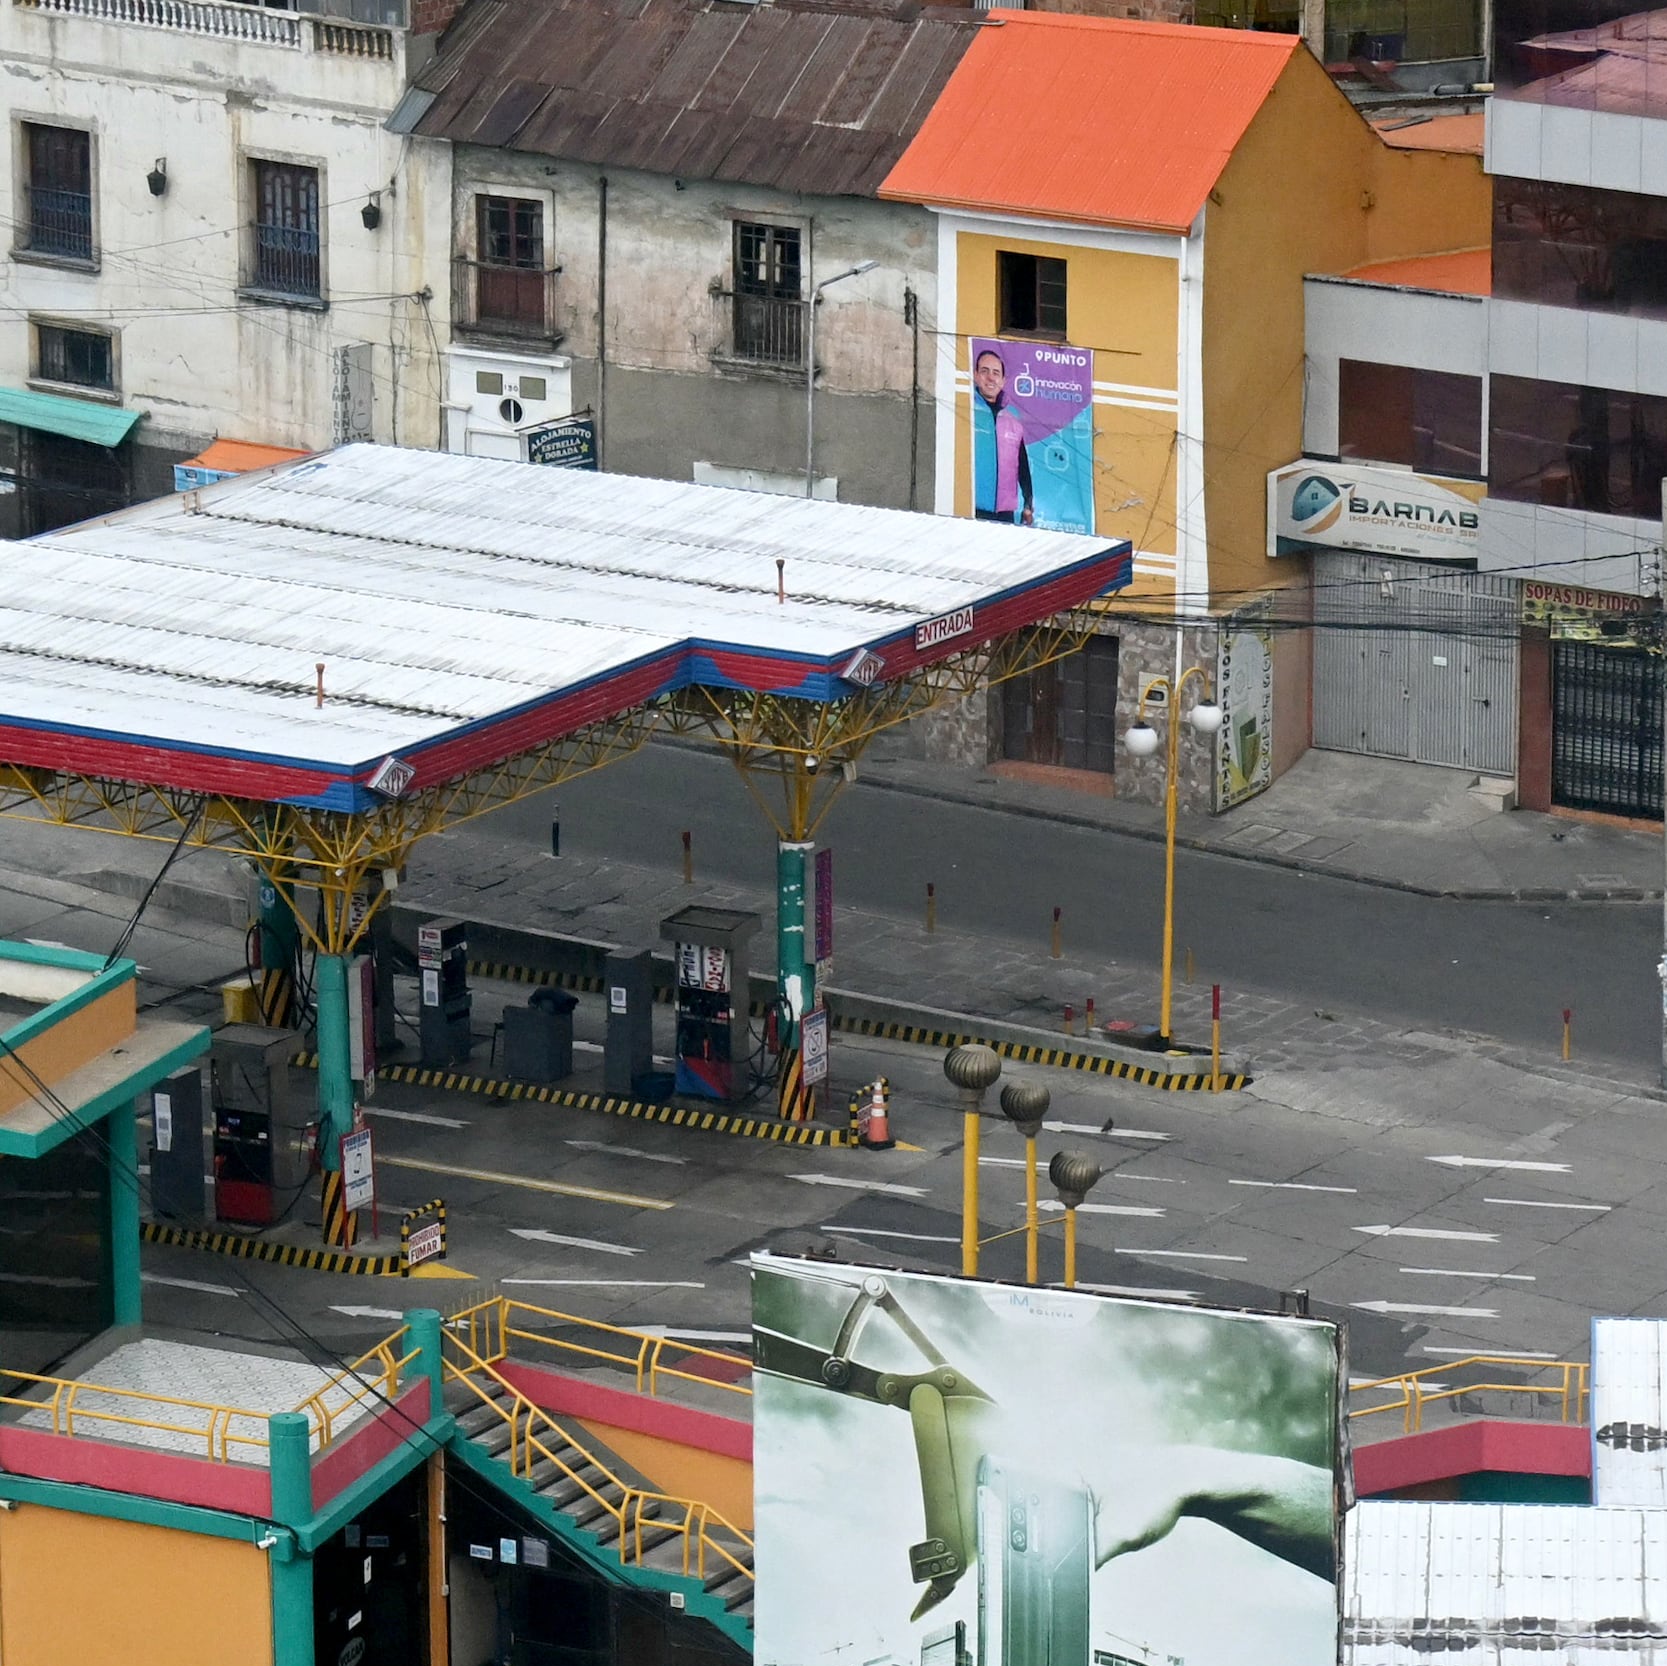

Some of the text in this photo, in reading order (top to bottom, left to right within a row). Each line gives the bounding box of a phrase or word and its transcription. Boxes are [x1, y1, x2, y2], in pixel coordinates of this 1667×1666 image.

[1044, 352, 1087, 367] PUNTO
[531, 428, 592, 452] ALOJAMIENTO
[541, 437, 581, 453] ESTRELLA
[545, 446, 578, 460] DORADA
[1350, 516, 1454, 534] IMPORTACIONES
[1525, 583, 1571, 604] SOPAS
[1575, 592, 1593, 607] DE
[916, 609, 972, 643] ENTRADA
[1221, 686, 1230, 807] FLOTANTES
[411, 1240, 438, 1263] FUMAR
[1030, 1308, 1074, 1318] BOLIVIA
